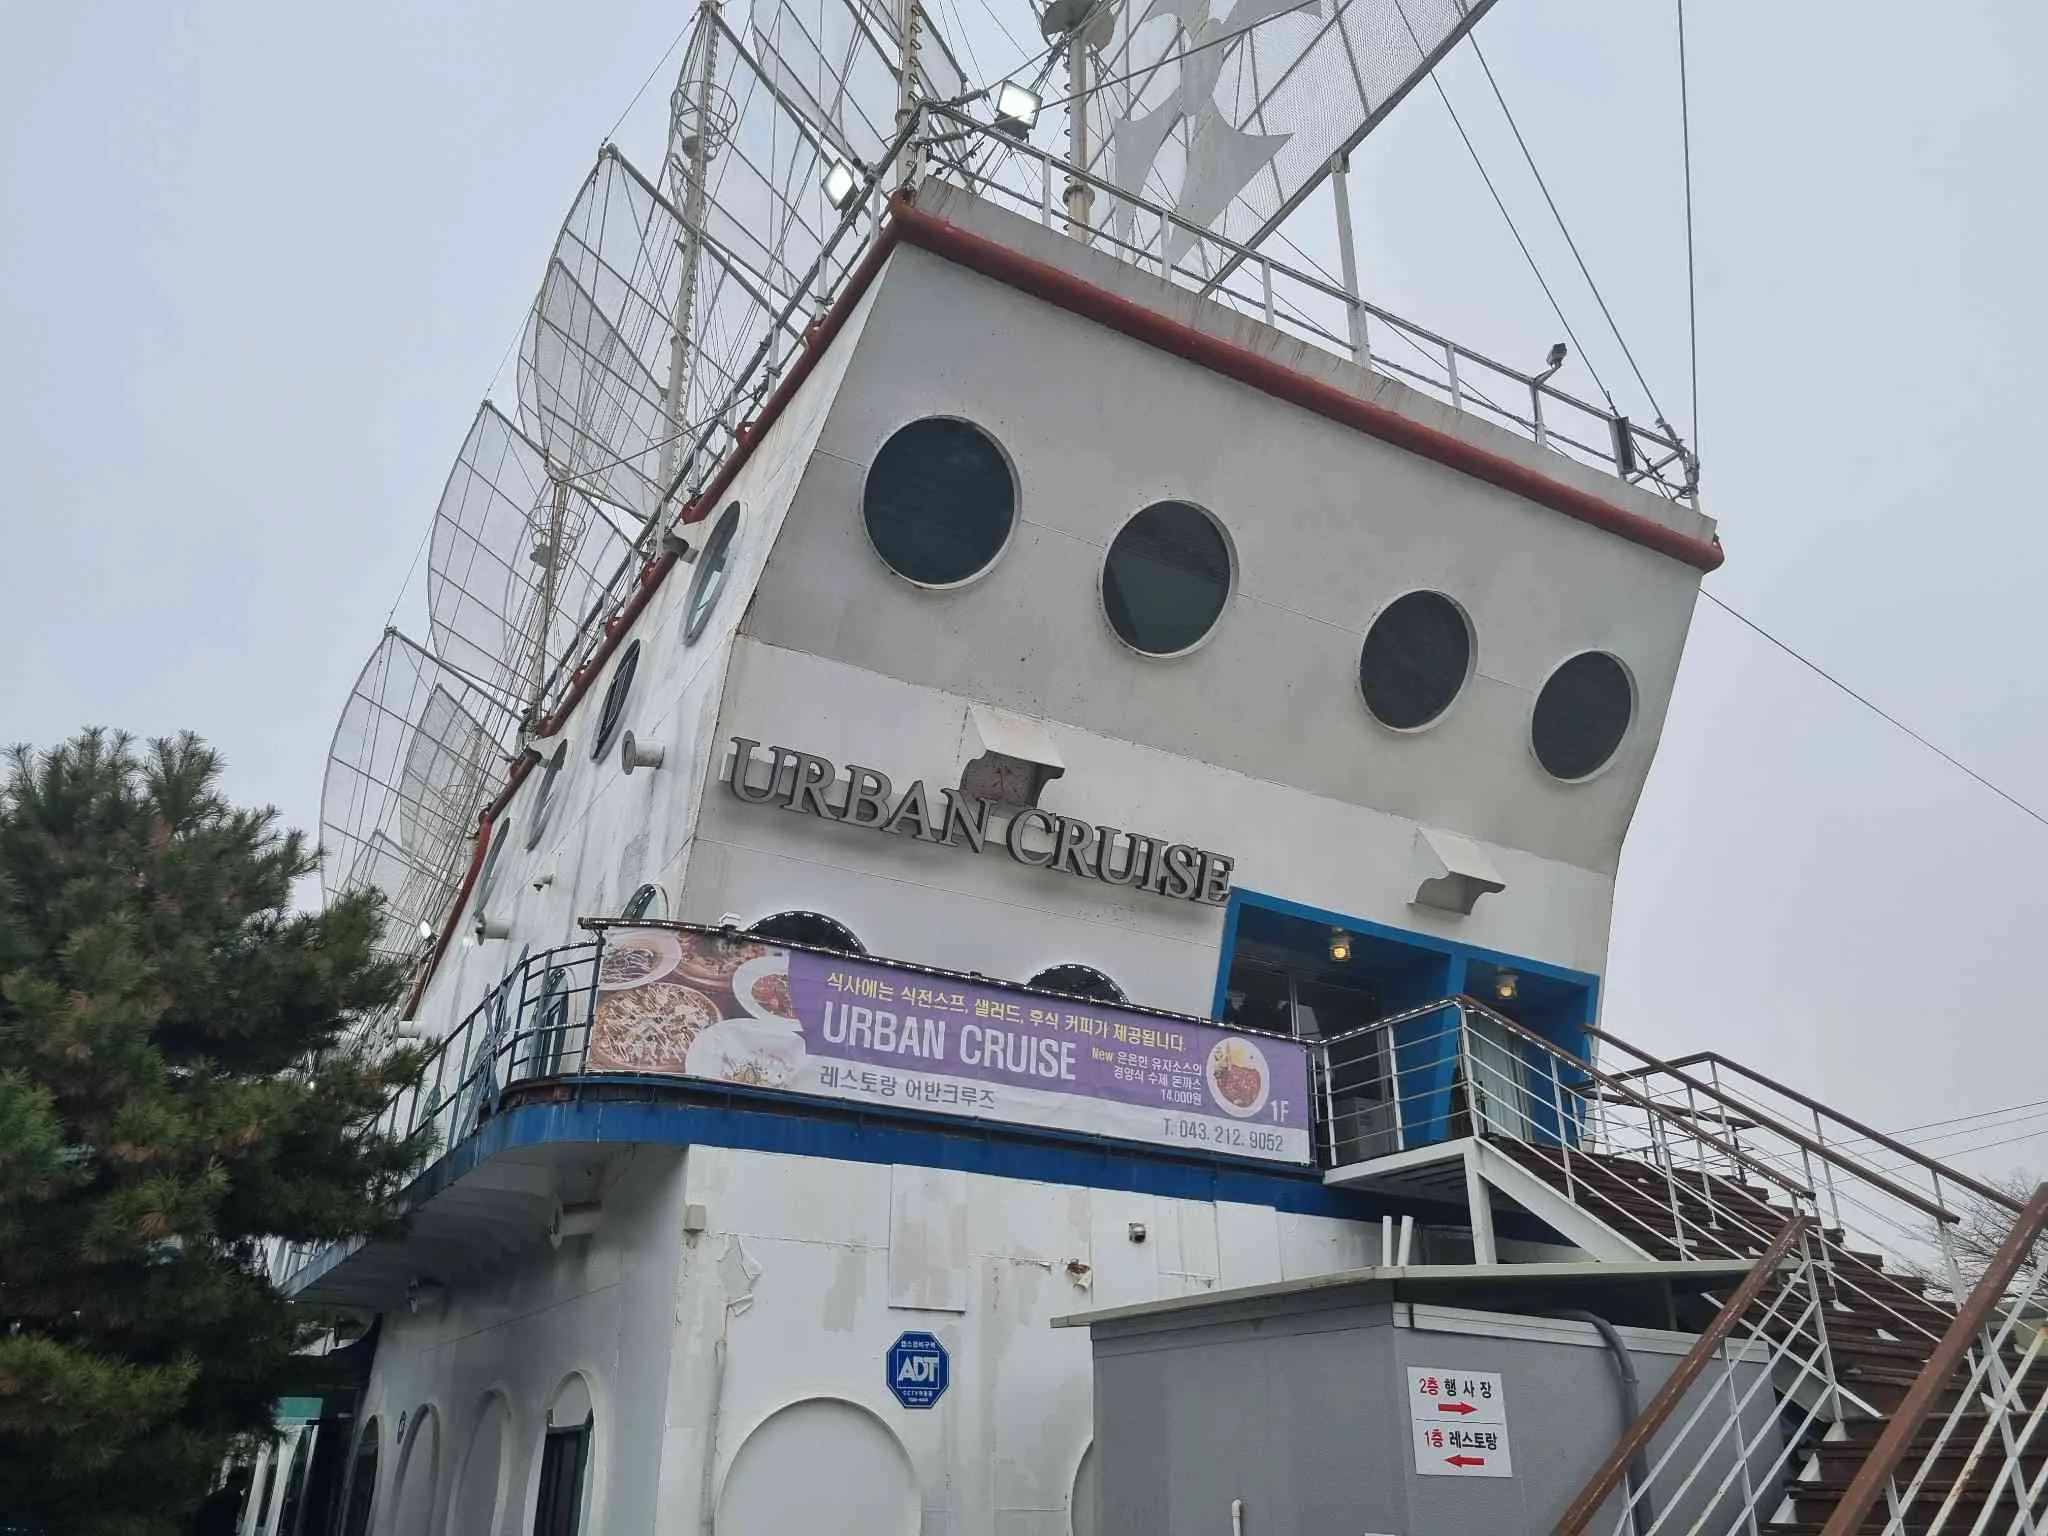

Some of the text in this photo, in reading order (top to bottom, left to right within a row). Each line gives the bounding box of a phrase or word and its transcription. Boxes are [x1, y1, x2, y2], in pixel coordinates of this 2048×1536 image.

[730, 736, 1235, 907] URBAN CRUISE
[826, 972, 894, 1002] 식사에는
[901, 986, 969, 1015] 식전스프,
[974, 998, 1024, 1025] 샐러드,
[1029, 1008, 1059, 1031] 후식
[1065, 1014, 1108, 1039] 커피가
[822, 1000, 1077, 1081] URBAN CRUISE
[1091, 1047, 1114, 1064] New
[820, 1064, 996, 1110] 레스토랑 어반크루즈
[1113, 1065, 1144, 1084] 경양식
[1147, 1072, 1168, 1088] 수제
[1270, 1100, 1290, 1123] 1F
[1250, 1132, 1284, 1152] 9052
[898, 1355, 939, 1382] ADT
[1419, 1376, 1439, 1396] 2층
[1424, 1428, 1498, 1451] 1층 레스토랑
